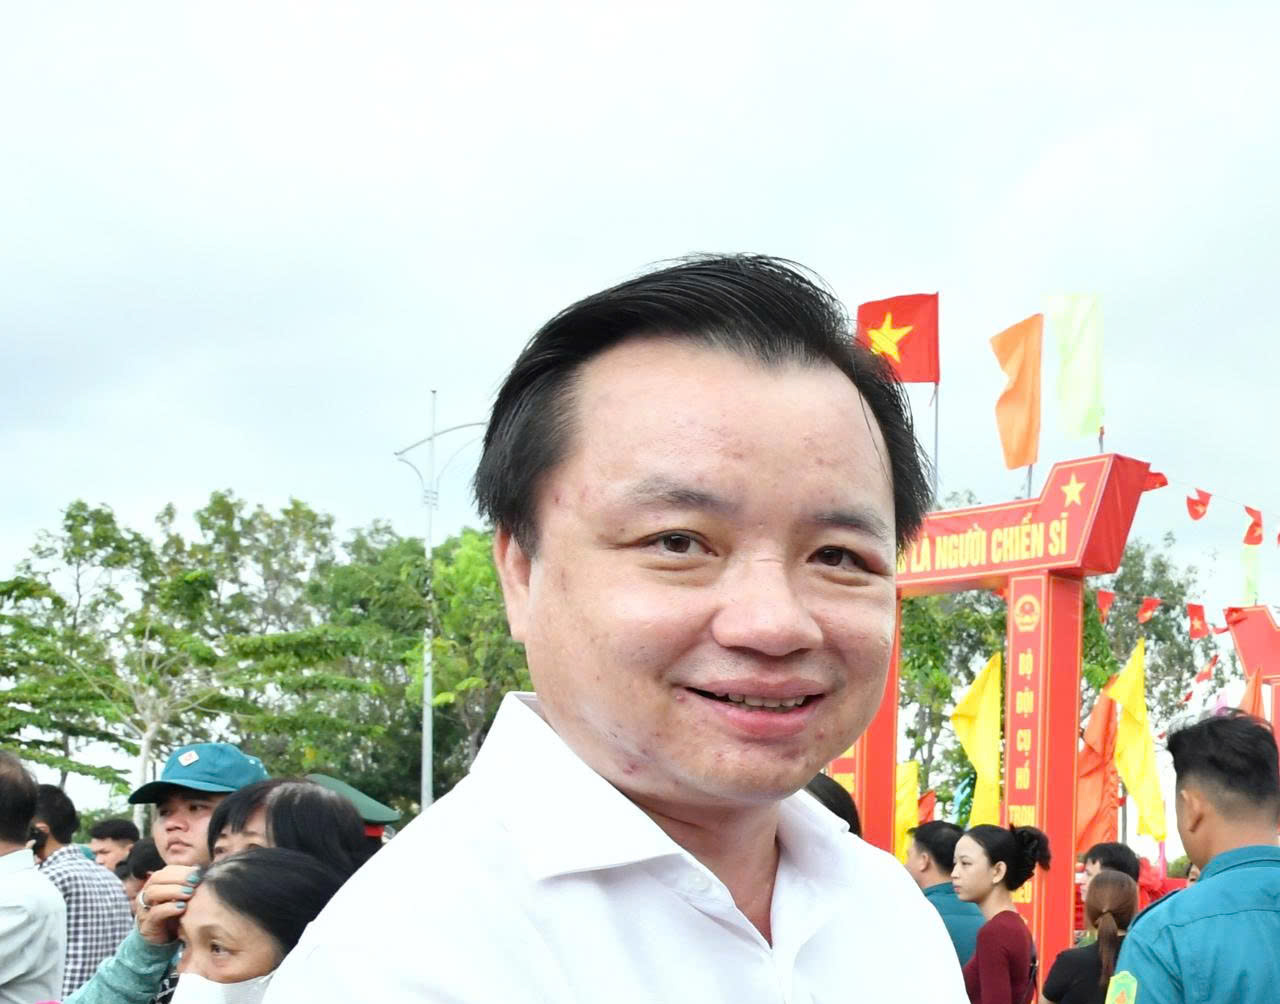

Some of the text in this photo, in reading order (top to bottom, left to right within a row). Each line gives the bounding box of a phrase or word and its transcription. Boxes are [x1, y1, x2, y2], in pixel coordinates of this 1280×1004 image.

[935, 522, 987, 571] NGƯỜI
[991, 511, 1045, 564] CHIẾN
[1048, 511, 1069, 556] SĨ
